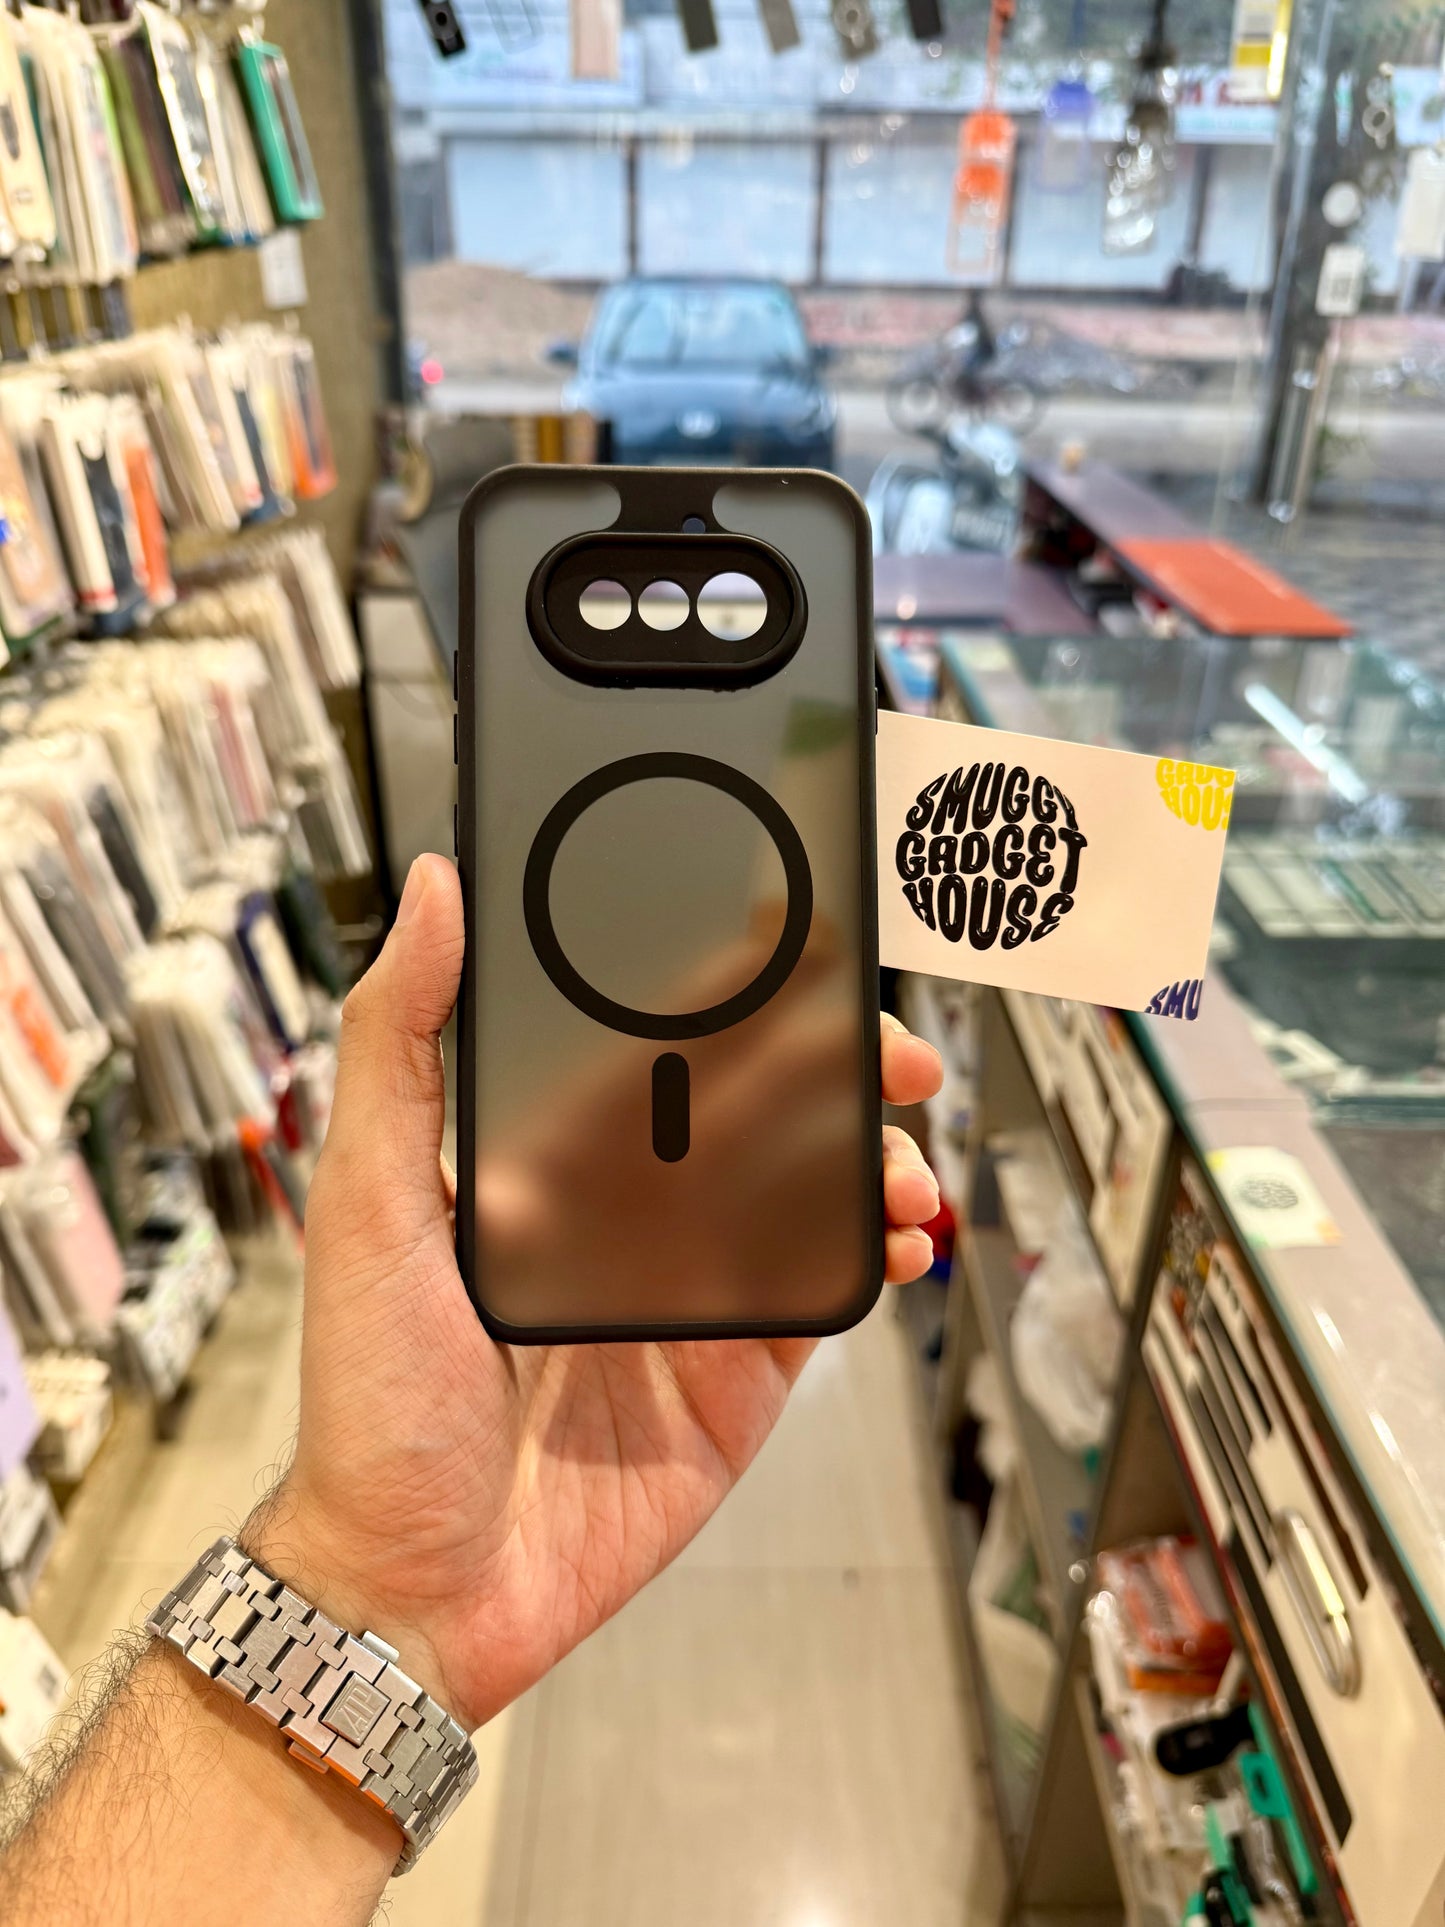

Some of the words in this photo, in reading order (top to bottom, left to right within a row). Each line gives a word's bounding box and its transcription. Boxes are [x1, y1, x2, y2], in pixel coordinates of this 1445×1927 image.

[906, 762, 1078, 835] SMUGGY
[896, 823, 1088, 894] GADGET
[902, 874, 1075, 951] HOUSE
[1143, 978, 1204, 1021] SMU
